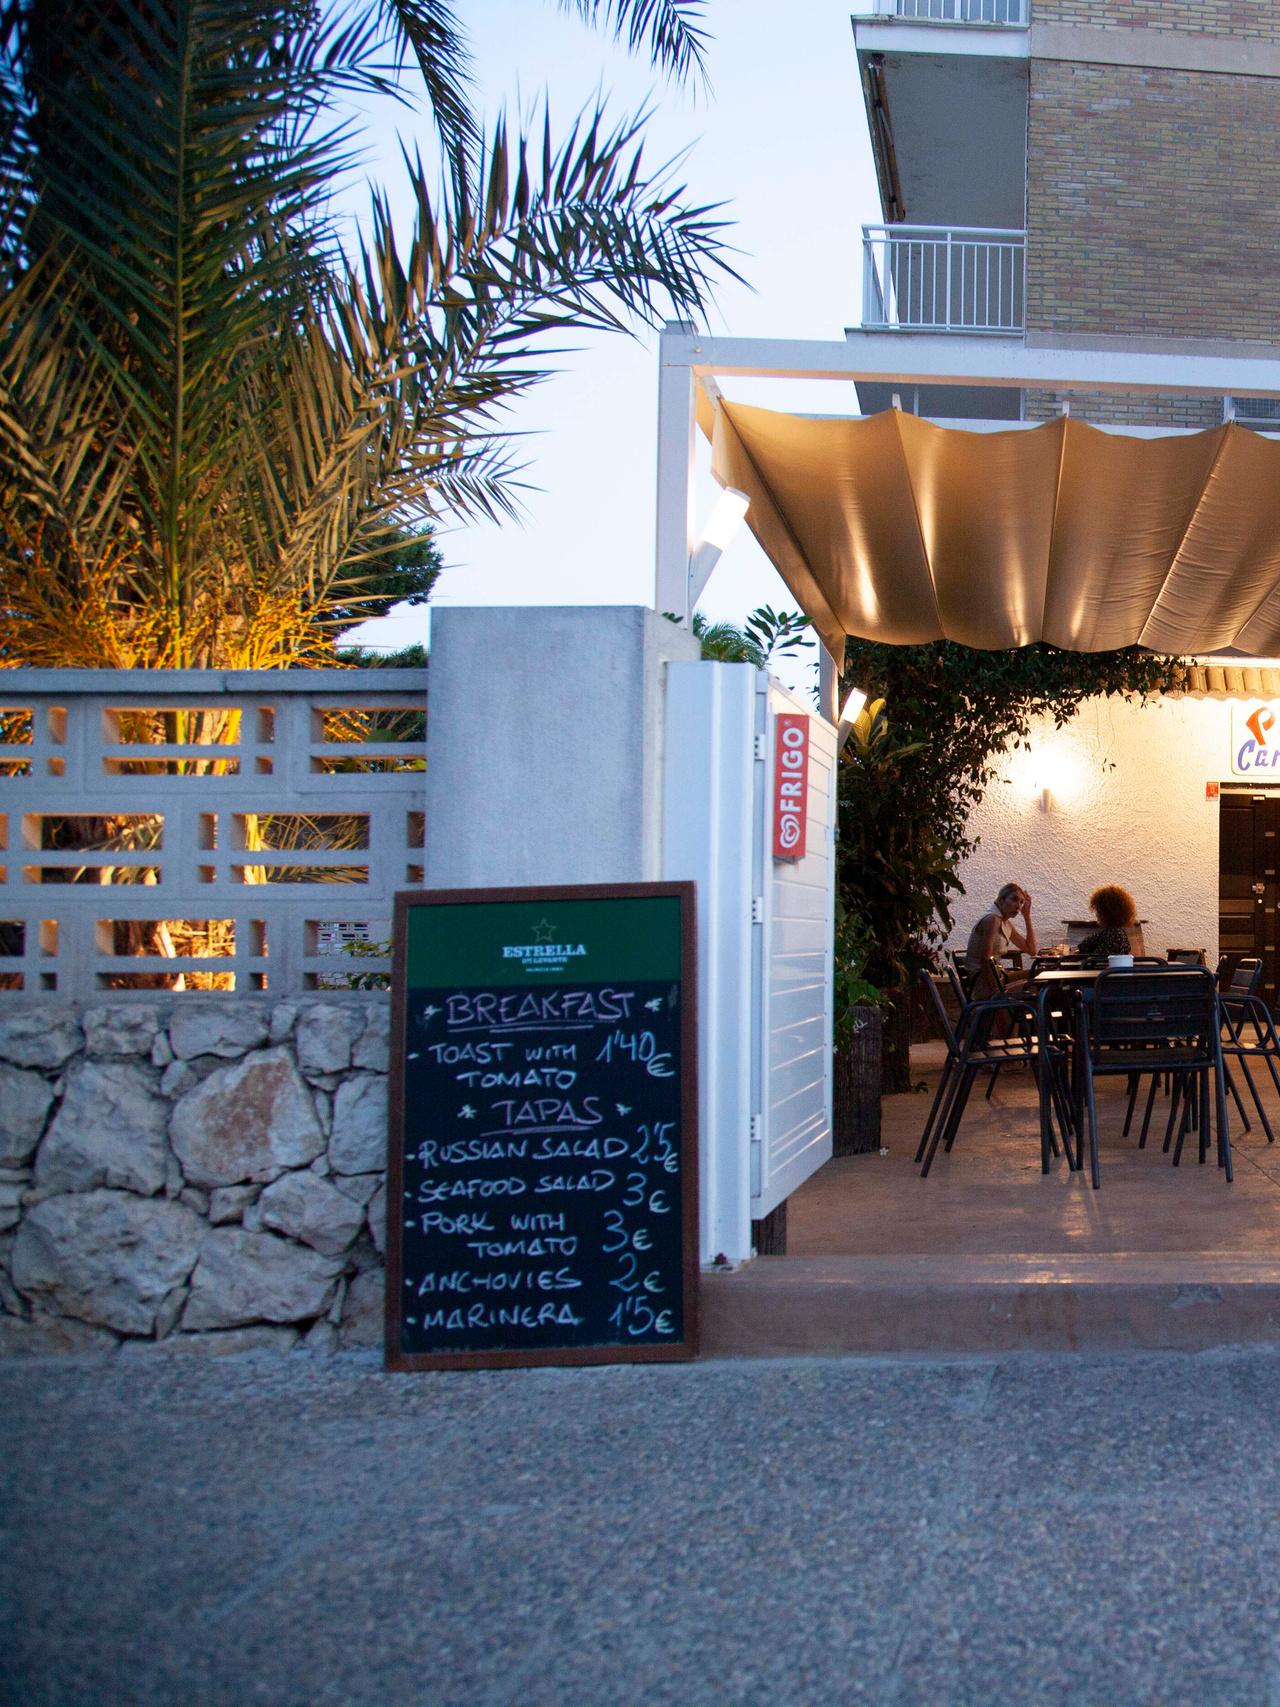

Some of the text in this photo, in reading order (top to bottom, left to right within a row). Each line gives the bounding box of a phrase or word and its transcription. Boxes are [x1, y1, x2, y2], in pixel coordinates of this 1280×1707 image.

[780, 727, 805, 813] FRIGO
[502, 944, 587, 958] ESTRELLA
[446, 988, 635, 1025] BREAKFAST
[428, 1042, 514, 1064] TOAST
[456, 1067, 577, 1090] TOMATO
[491, 1096, 603, 1126] TAPAS
[418, 1140, 528, 1169] RUSSIAN
[532, 1137, 629, 1160] SALAD
[417, 1177, 526, 1203] SEAFOOD
[534, 1169, 616, 1193] SALAD
[420, 1212, 496, 1235] PORK
[511, 1213, 565, 1231] WITH
[467, 1236, 578, 1258] TOMATO
[418, 1267, 582, 1297] ANCHOVIES
[423, 1303, 585, 1330] MARINERA
